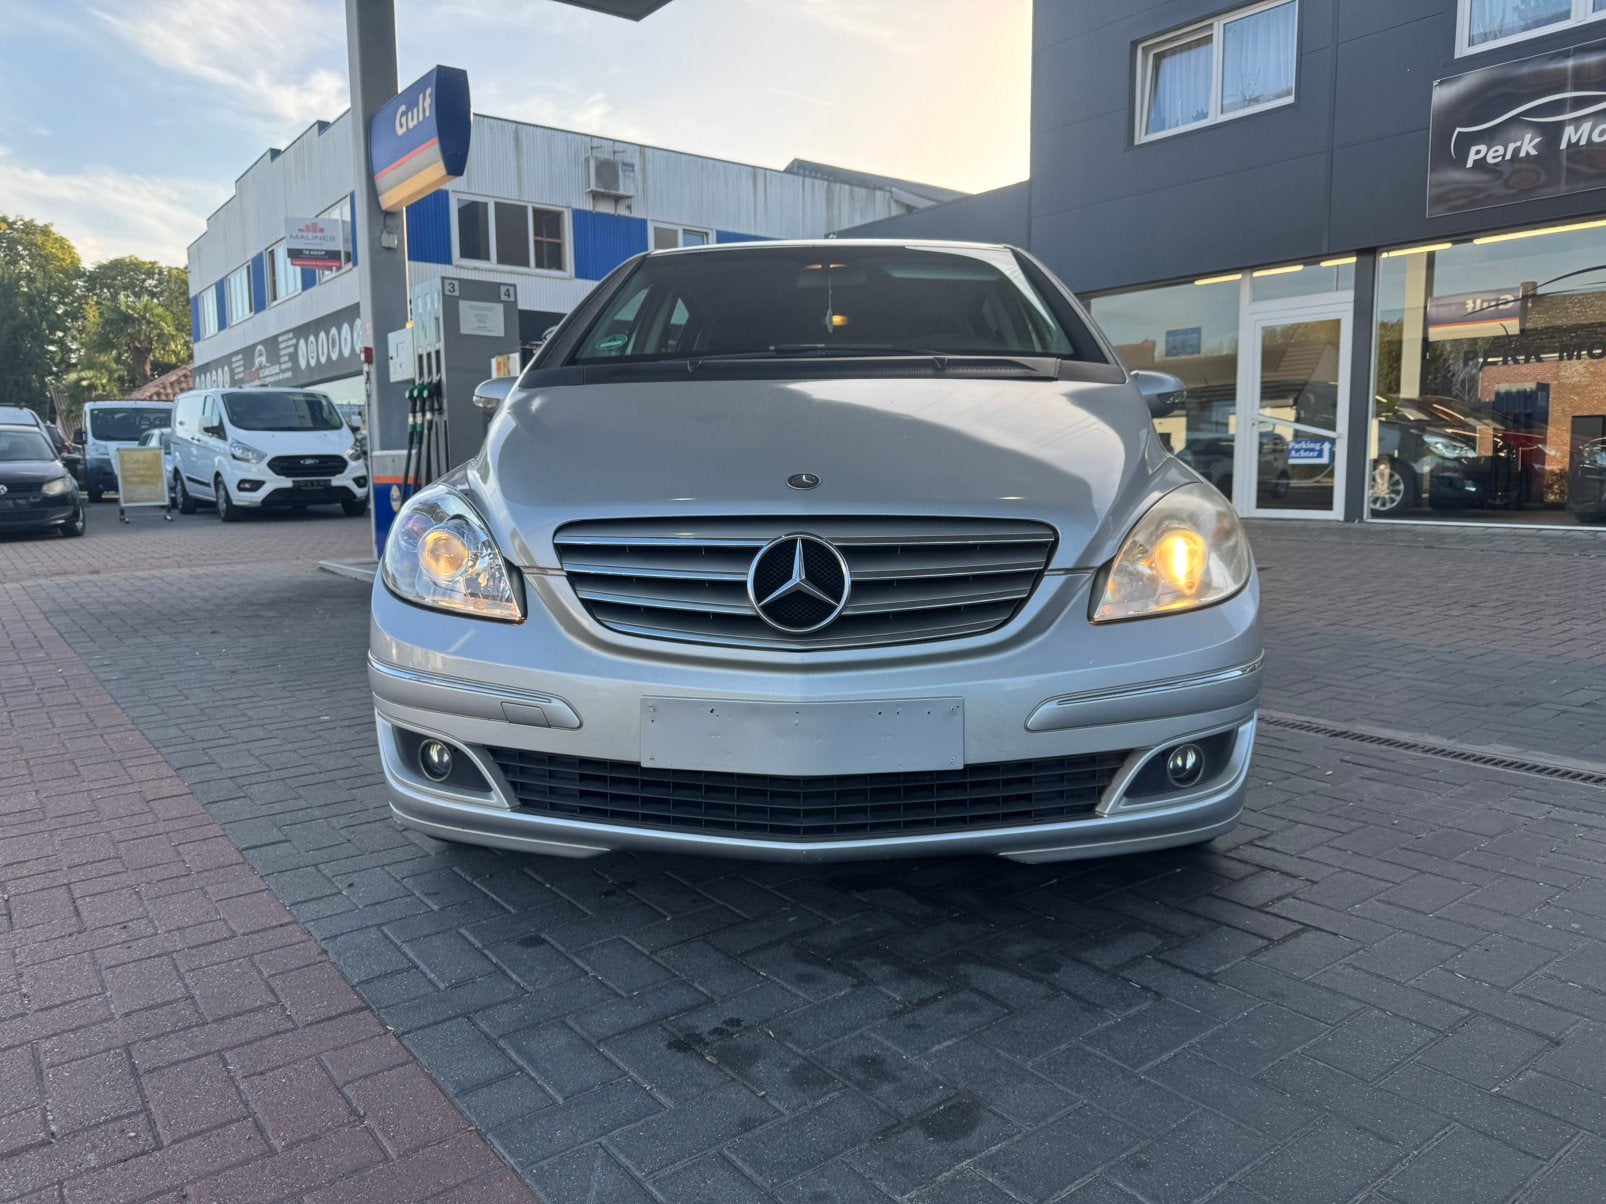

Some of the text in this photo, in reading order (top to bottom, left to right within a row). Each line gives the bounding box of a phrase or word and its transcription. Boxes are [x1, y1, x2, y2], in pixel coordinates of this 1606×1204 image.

[395, 87, 432, 136] Gulf
[1466, 133, 1543, 168] Perk
[447, 282, 456, 293] 3
[503, 288, 511, 299] 4
[1289, 440, 1322, 451] Parking
